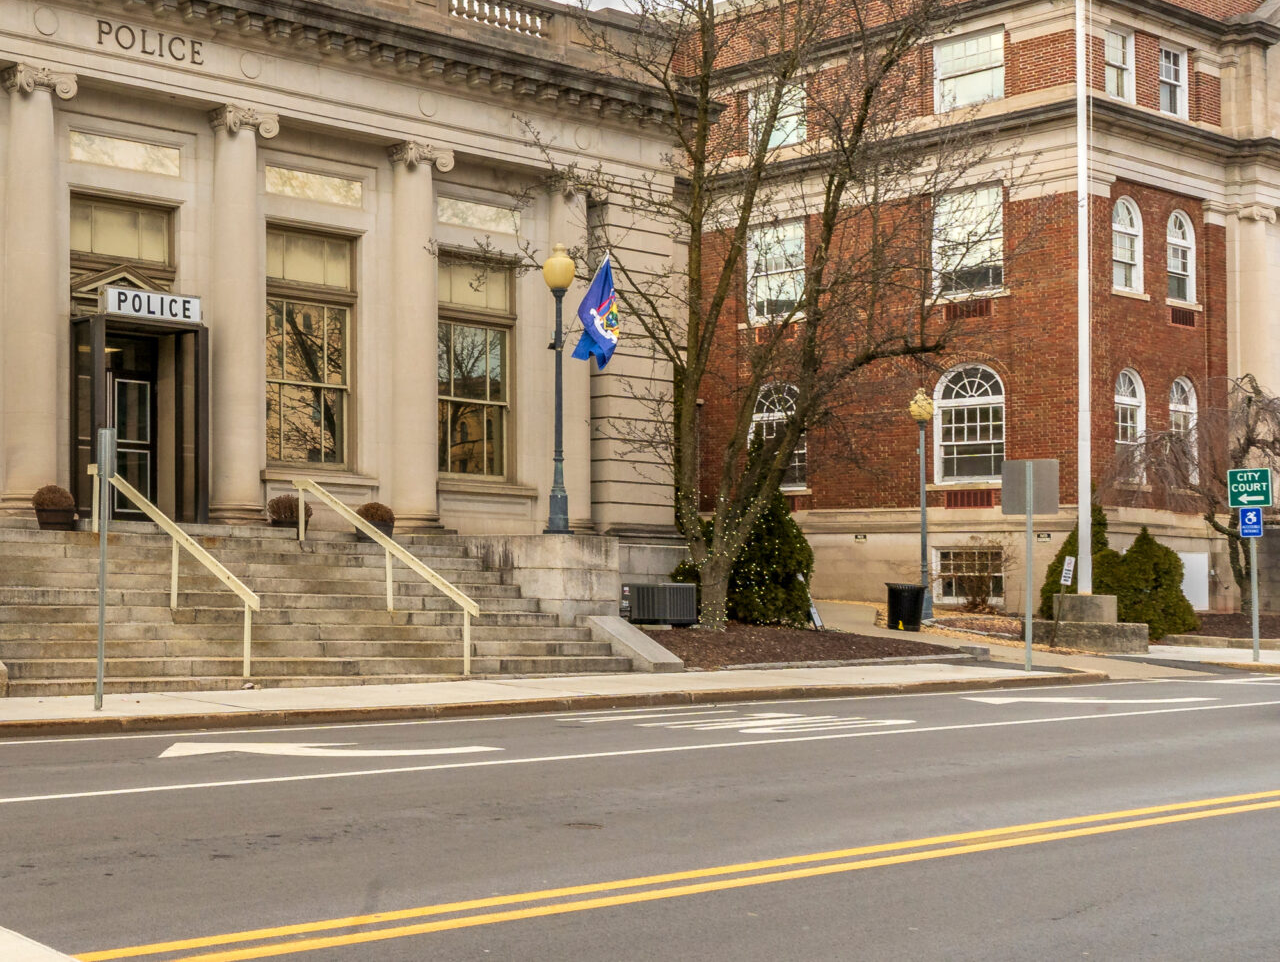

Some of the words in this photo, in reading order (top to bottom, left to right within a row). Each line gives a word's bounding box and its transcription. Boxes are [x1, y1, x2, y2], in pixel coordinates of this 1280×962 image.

[97, 19, 205, 66] POLICE
[117, 291, 192, 319] POLICE
[1237, 472, 1260, 481] CITY
[1231, 482, 1267, 492] COURT
